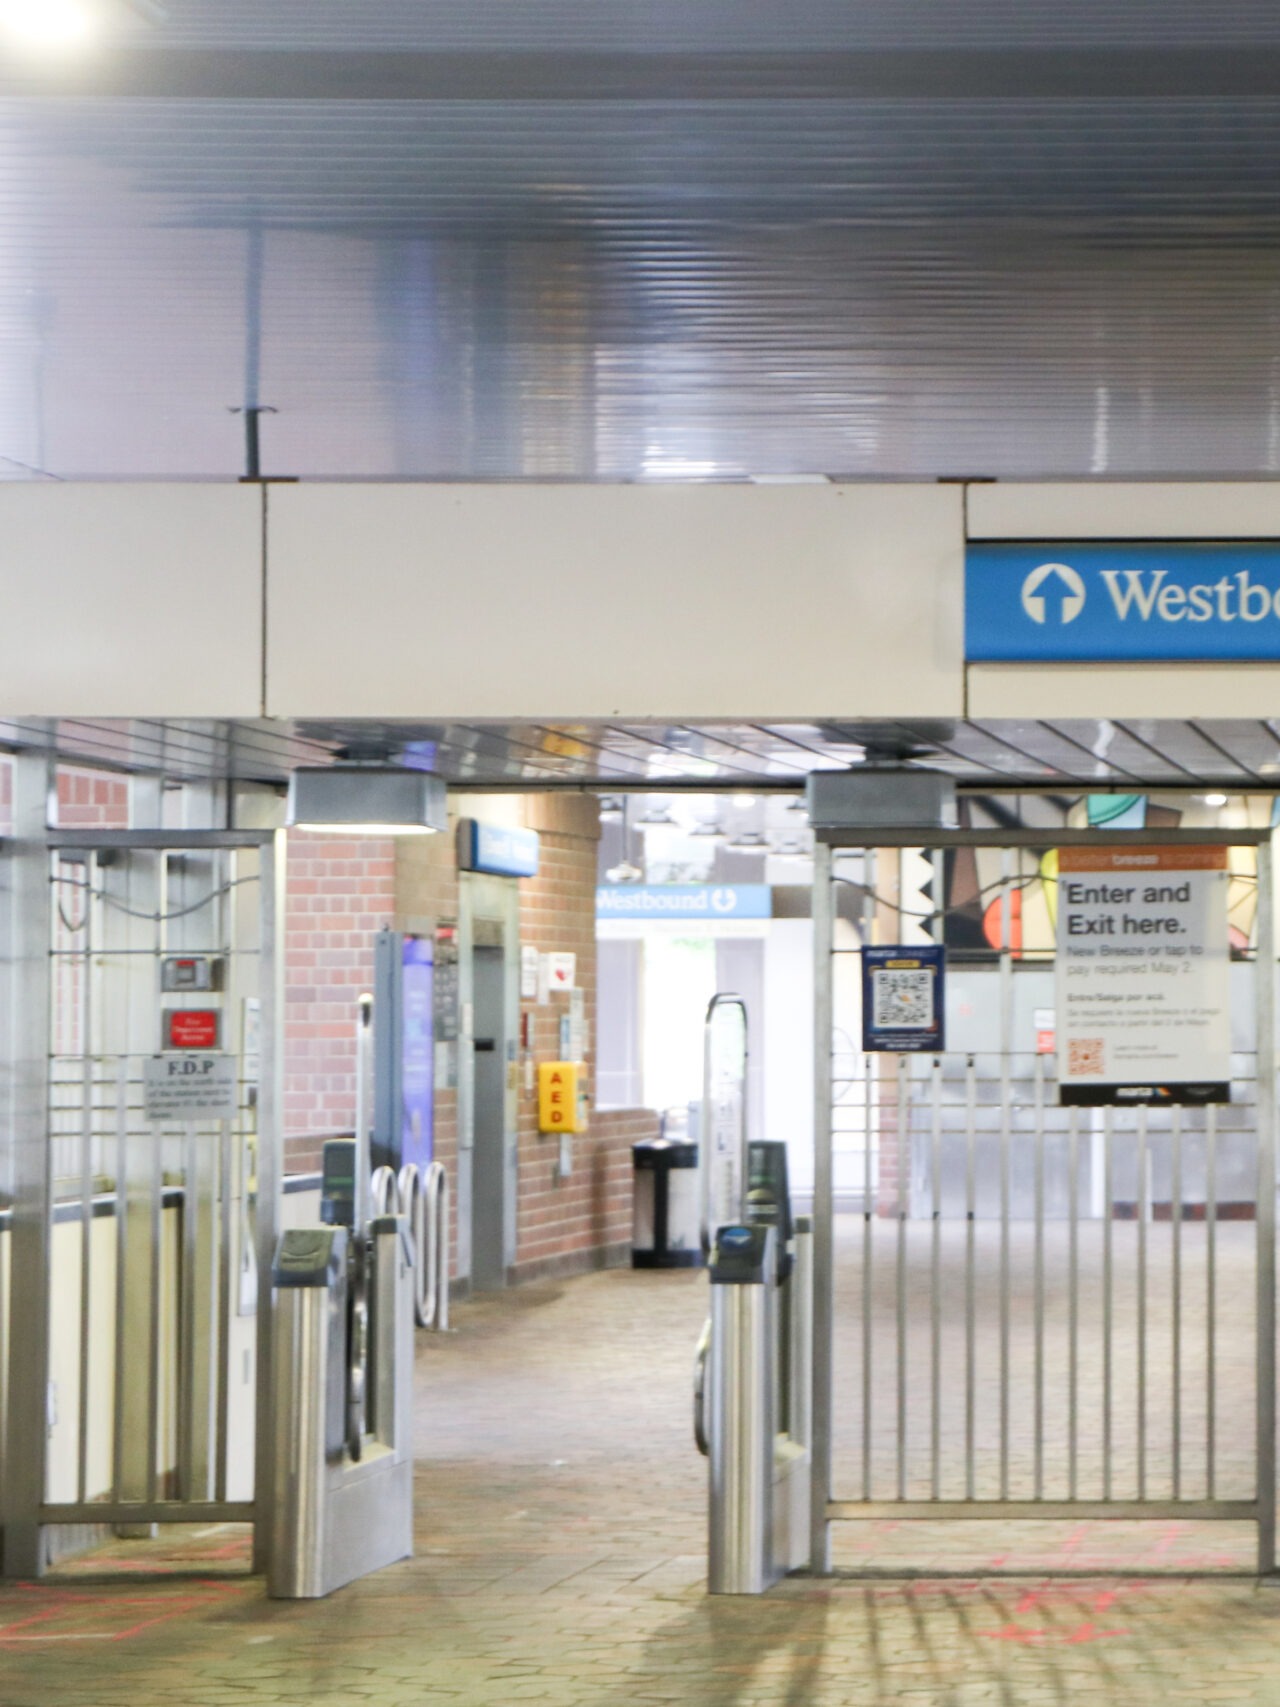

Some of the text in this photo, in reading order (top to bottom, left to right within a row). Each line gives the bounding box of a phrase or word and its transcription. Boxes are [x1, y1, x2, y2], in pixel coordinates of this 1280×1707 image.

[1066, 881, 1191, 904] Enter and
[1066, 912, 1187, 935] Exit here.
[1066, 943, 1204, 958] New Breeze or tap to
[1066, 964, 1090, 977] pay
[1094, 962, 1148, 977] required
[1151, 961, 1179, 977] May
